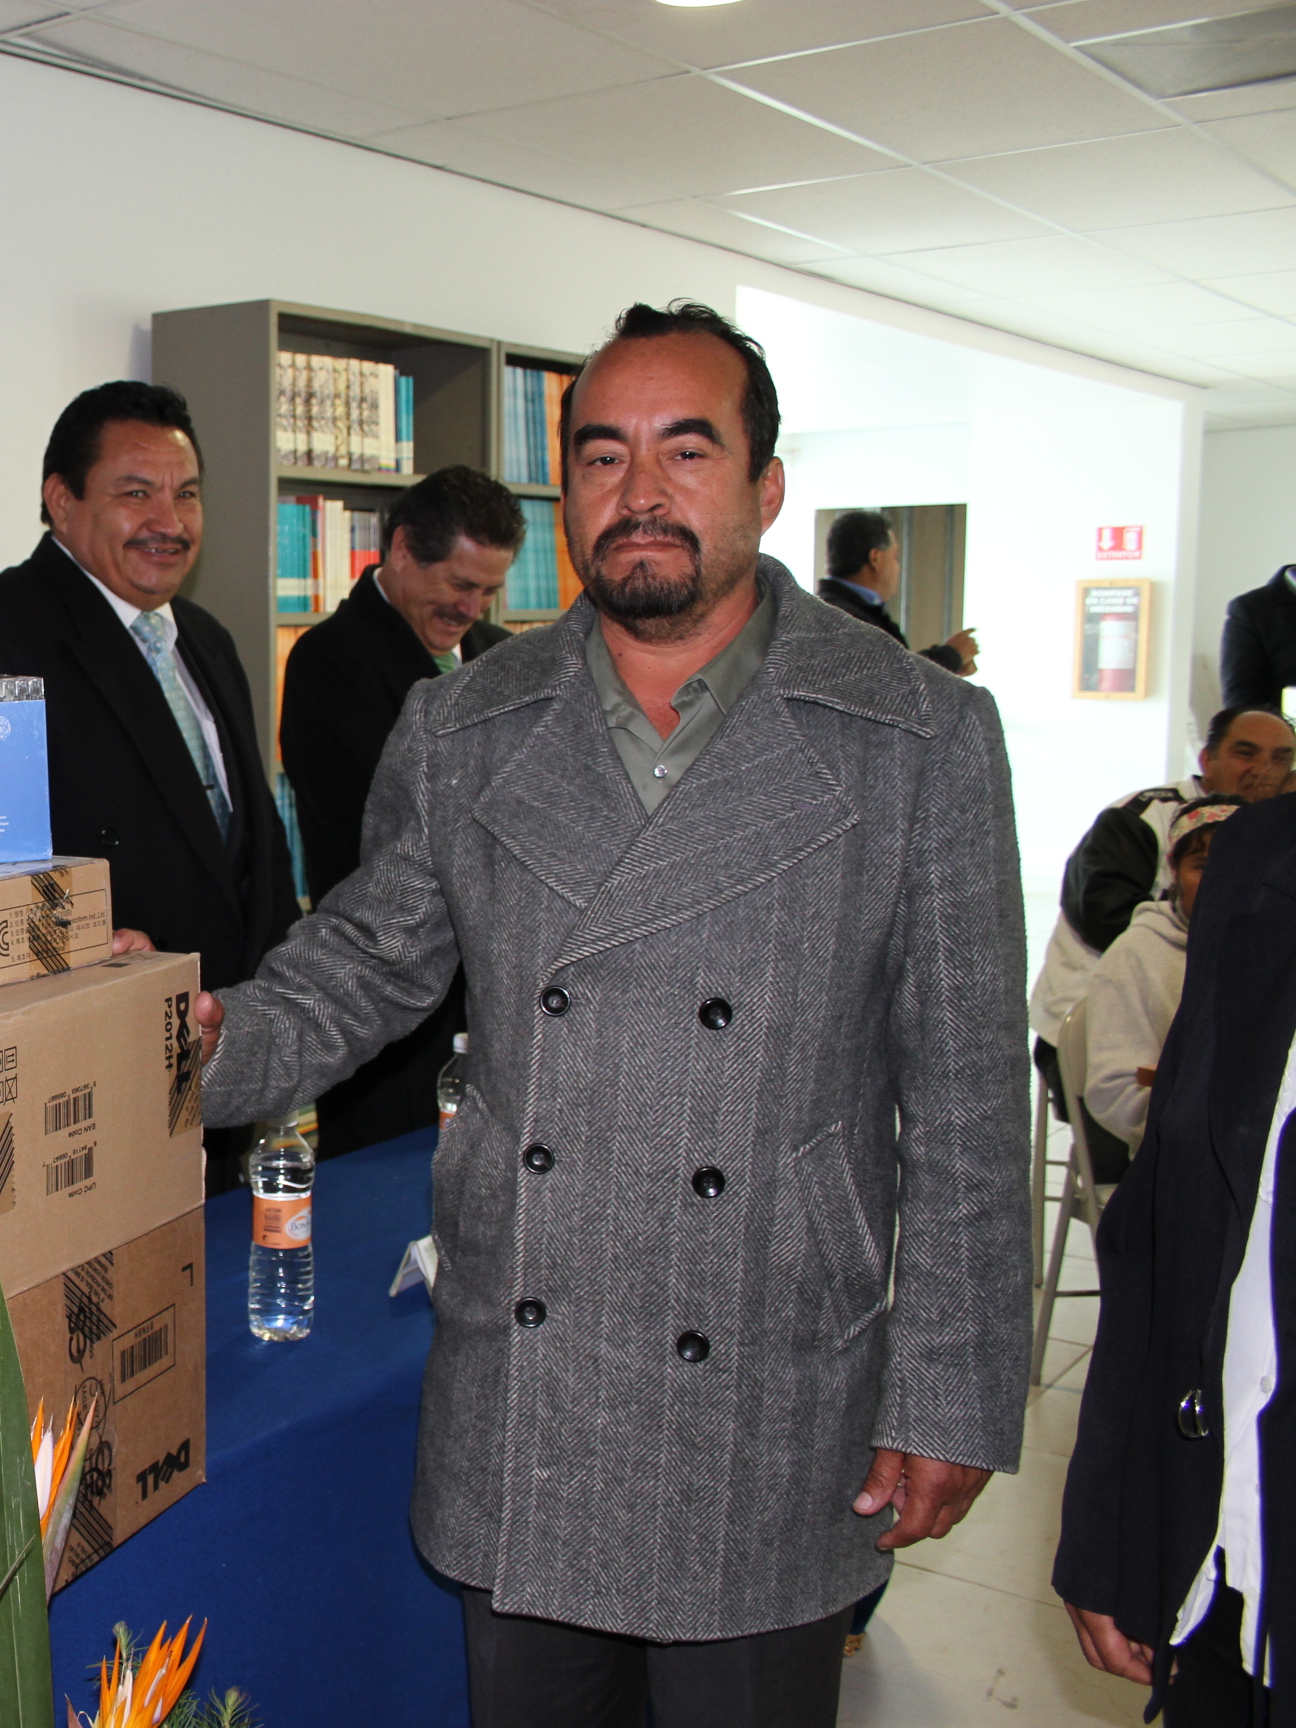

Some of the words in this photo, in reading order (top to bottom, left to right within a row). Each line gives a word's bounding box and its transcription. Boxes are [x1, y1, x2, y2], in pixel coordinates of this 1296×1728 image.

[165, 997, 174, 1070] P2012H
[176, 991, 191, 1095] DELL
[68, 1128, 83, 1138] Code
[84, 1123, 96, 1133] EAN
[83, 1182, 96, 1192] UPC
[68, 1188, 83, 1198] Code
[136, 1438, 191, 1501] DELL
